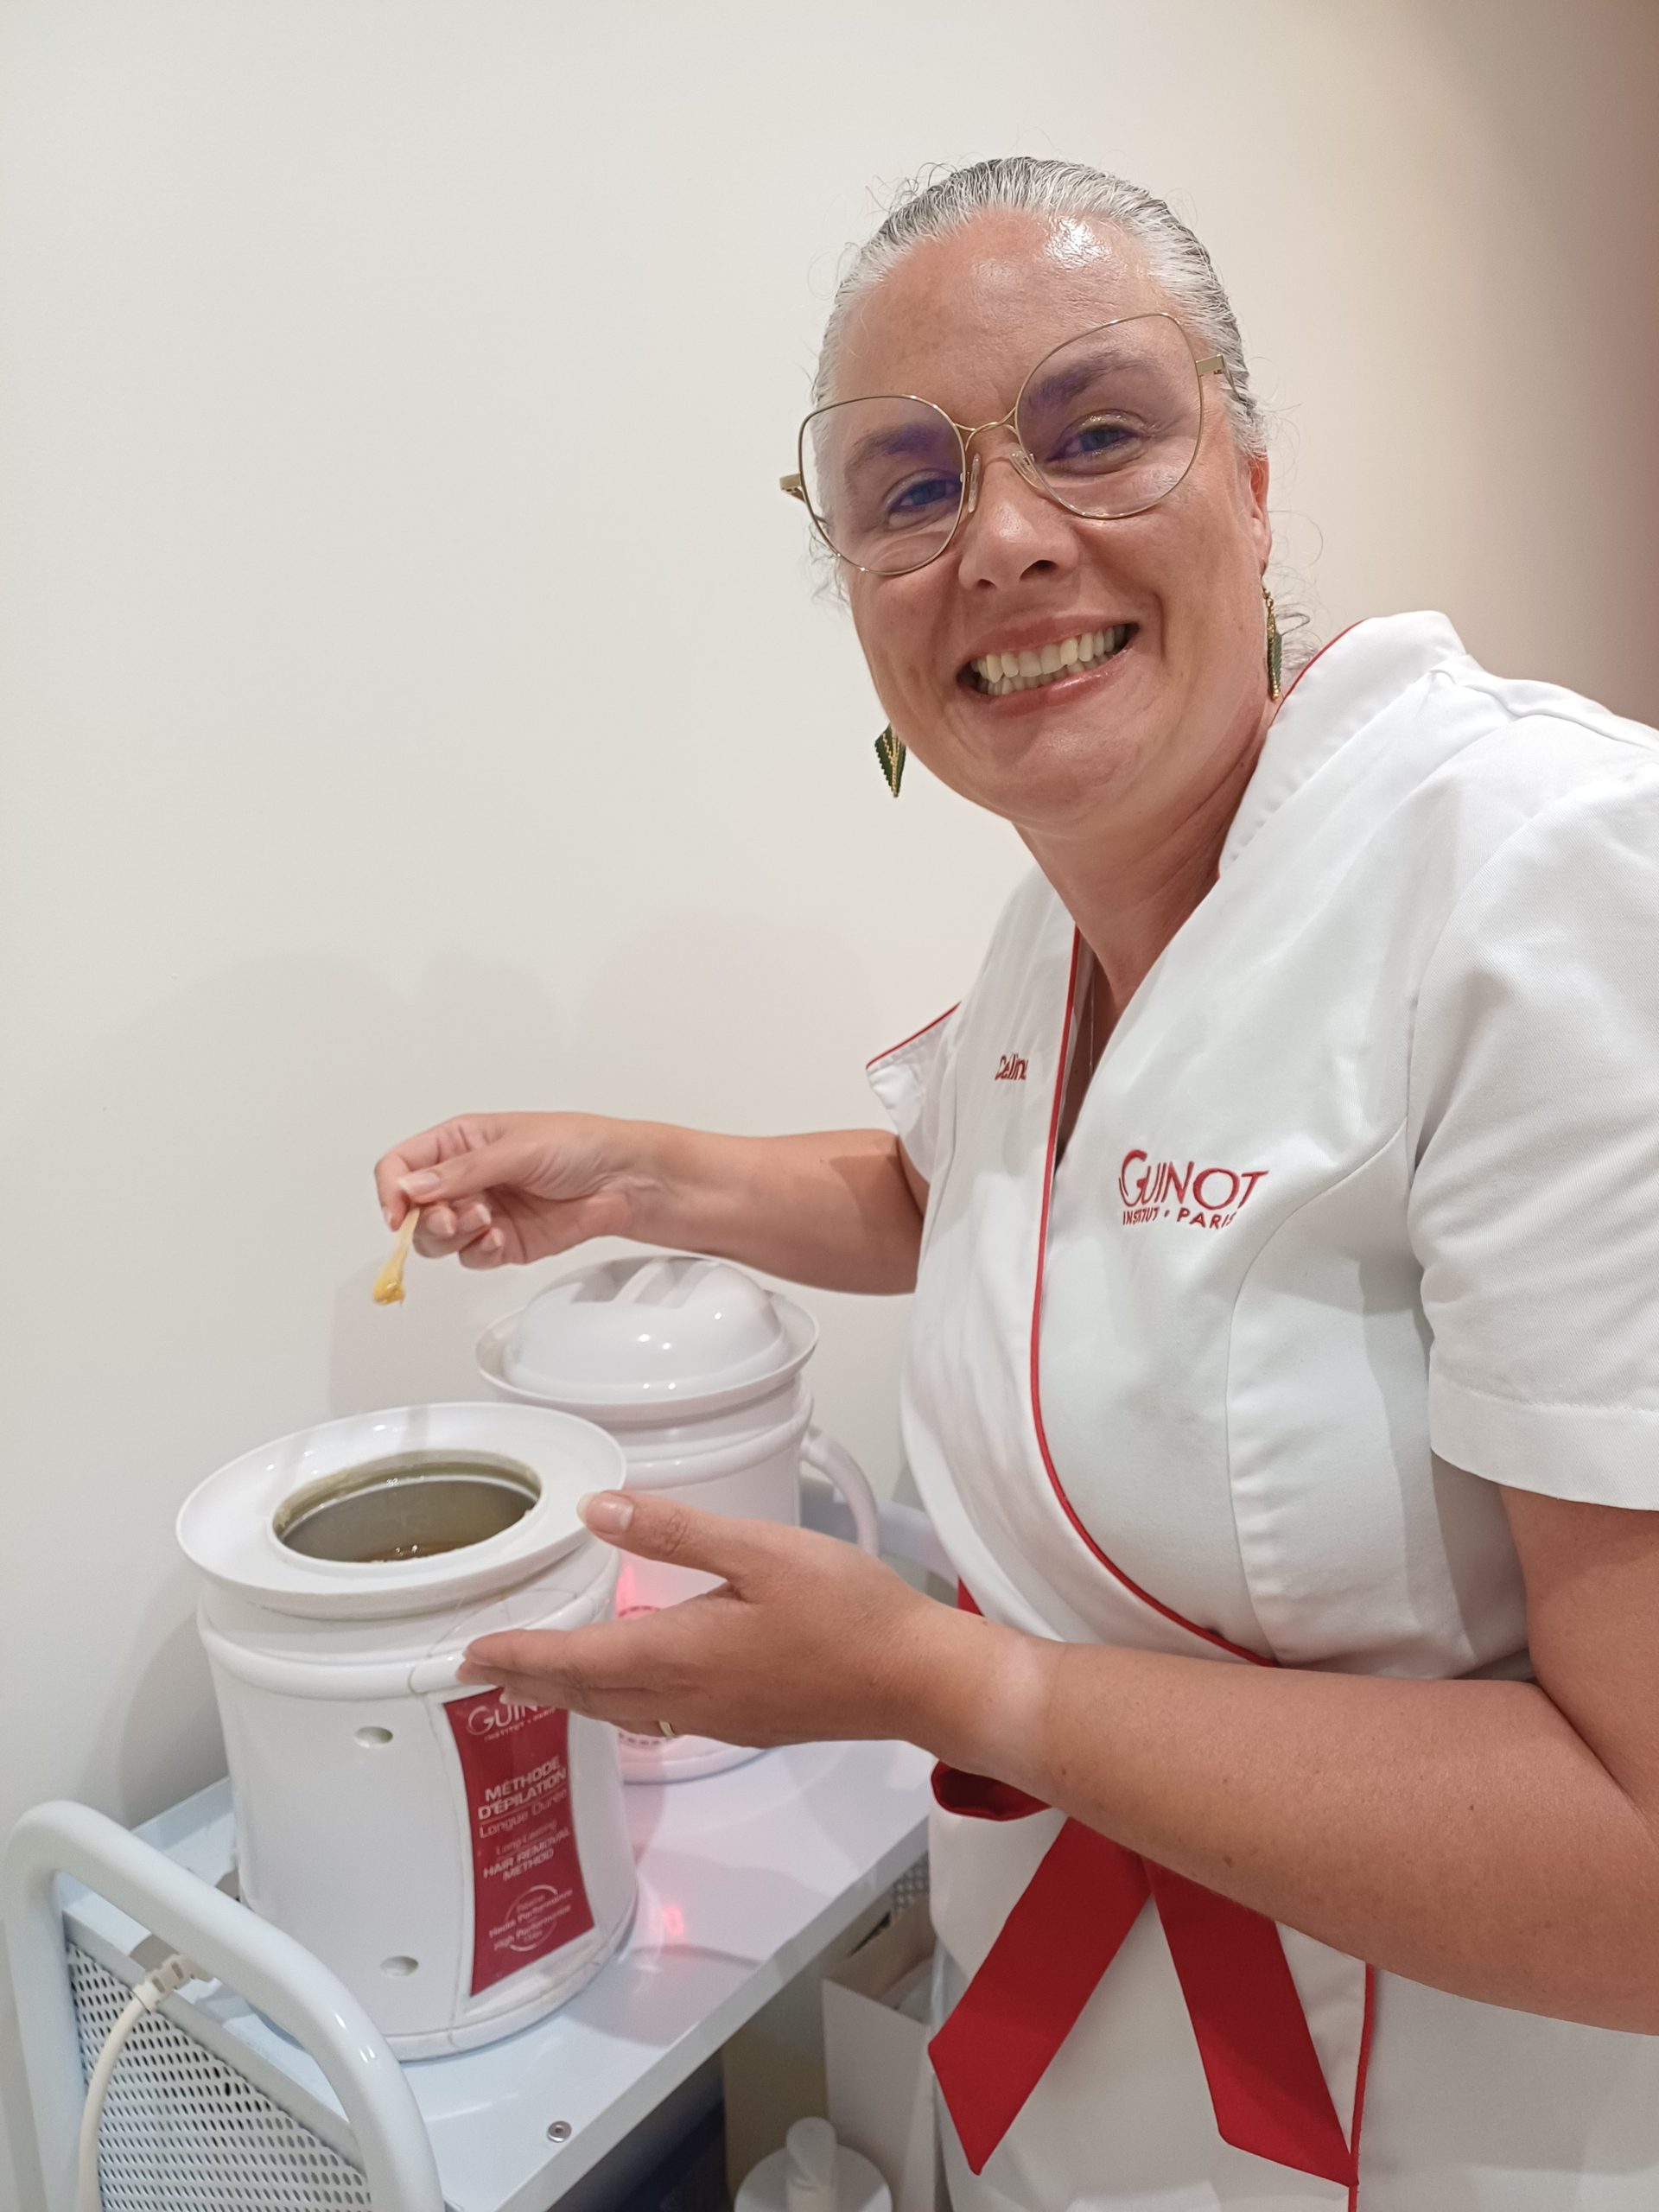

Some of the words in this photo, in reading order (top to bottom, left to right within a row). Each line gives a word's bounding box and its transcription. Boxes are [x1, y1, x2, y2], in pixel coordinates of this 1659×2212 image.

[1118, 1149, 1269, 1211] GUINOT
[1176, 1206, 1237, 1230] PARIS
[480, 1810, 528, 1839] Longue
[484, 1857, 514, 1878] HAIR
